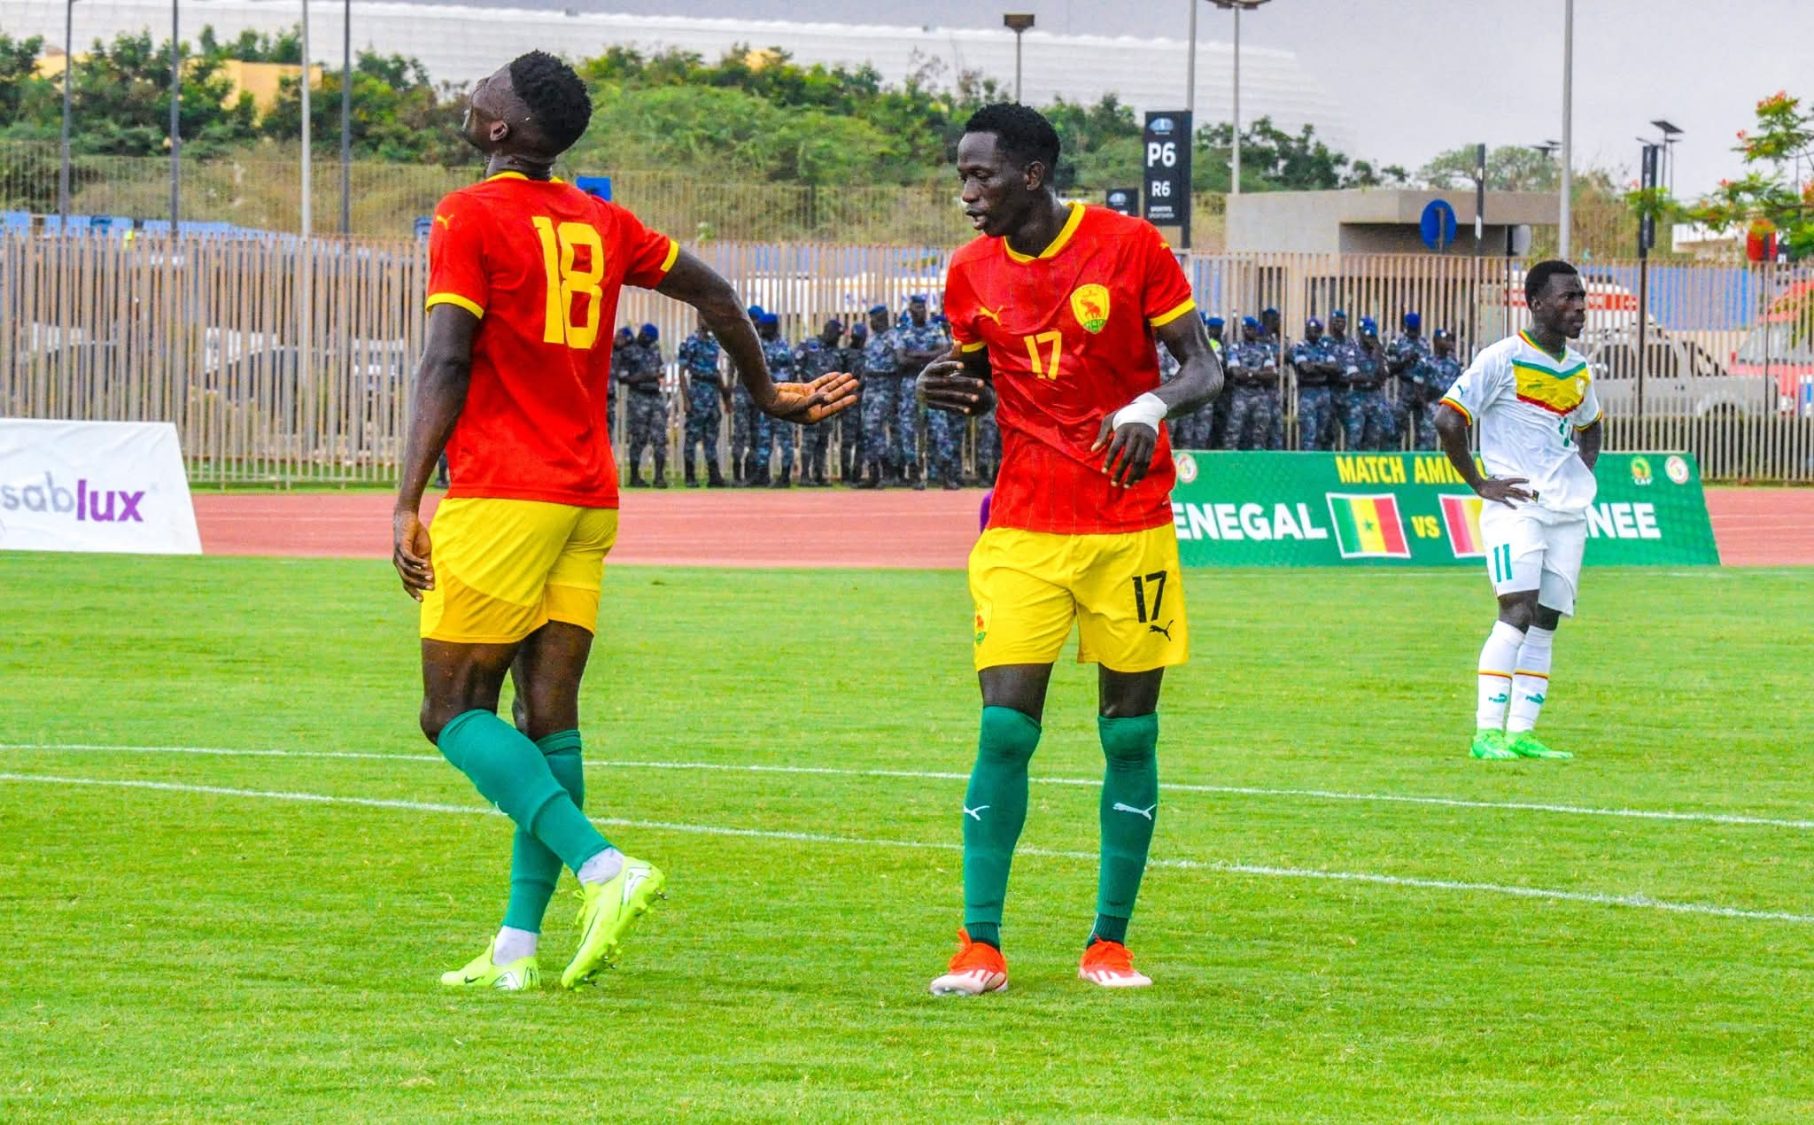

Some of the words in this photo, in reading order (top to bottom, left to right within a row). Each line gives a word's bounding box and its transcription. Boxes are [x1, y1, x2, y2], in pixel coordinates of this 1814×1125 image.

[1147, 142, 1177, 168] P6
[1151, 181, 1171, 197] R6
[531, 216, 604, 349] 18
[1023, 330, 1062, 380] 17
[1334, 456, 1406, 484] MATCH
[1414, 456, 1487, 484] AMI
[1, 471, 146, 522] sablux
[1171, 503, 1328, 540] ENEGAL
[1585, 502, 1662, 538] NEE
[1493, 543, 1512, 583] 11
[1132, 570, 1167, 623] 17
